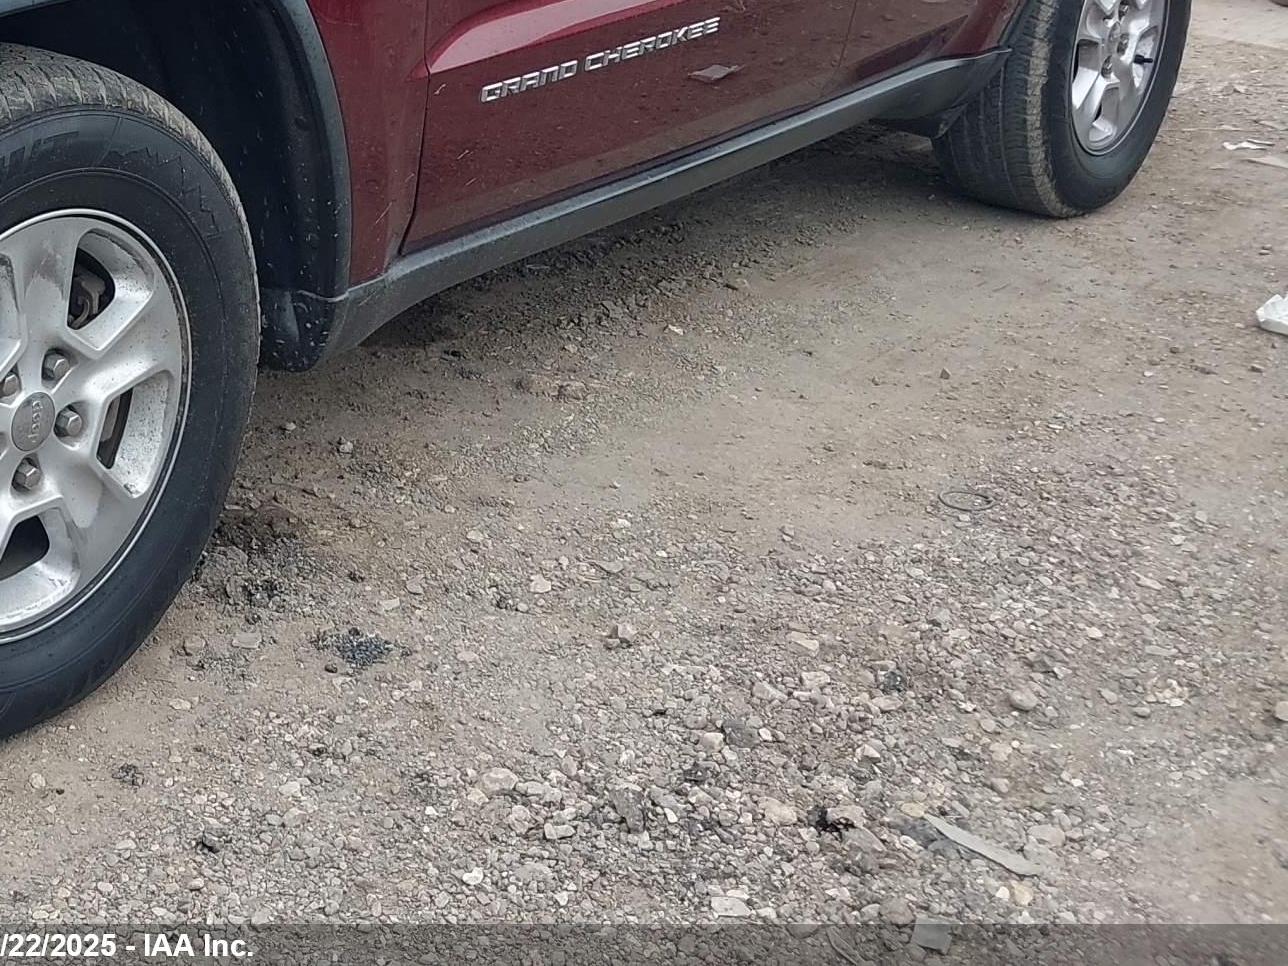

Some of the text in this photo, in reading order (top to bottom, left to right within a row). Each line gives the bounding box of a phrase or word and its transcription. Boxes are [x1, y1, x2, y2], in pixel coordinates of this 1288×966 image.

[479, 16, 721, 104] GRAND CHEROKEE
[26, 400, 44, 442] Jeep
